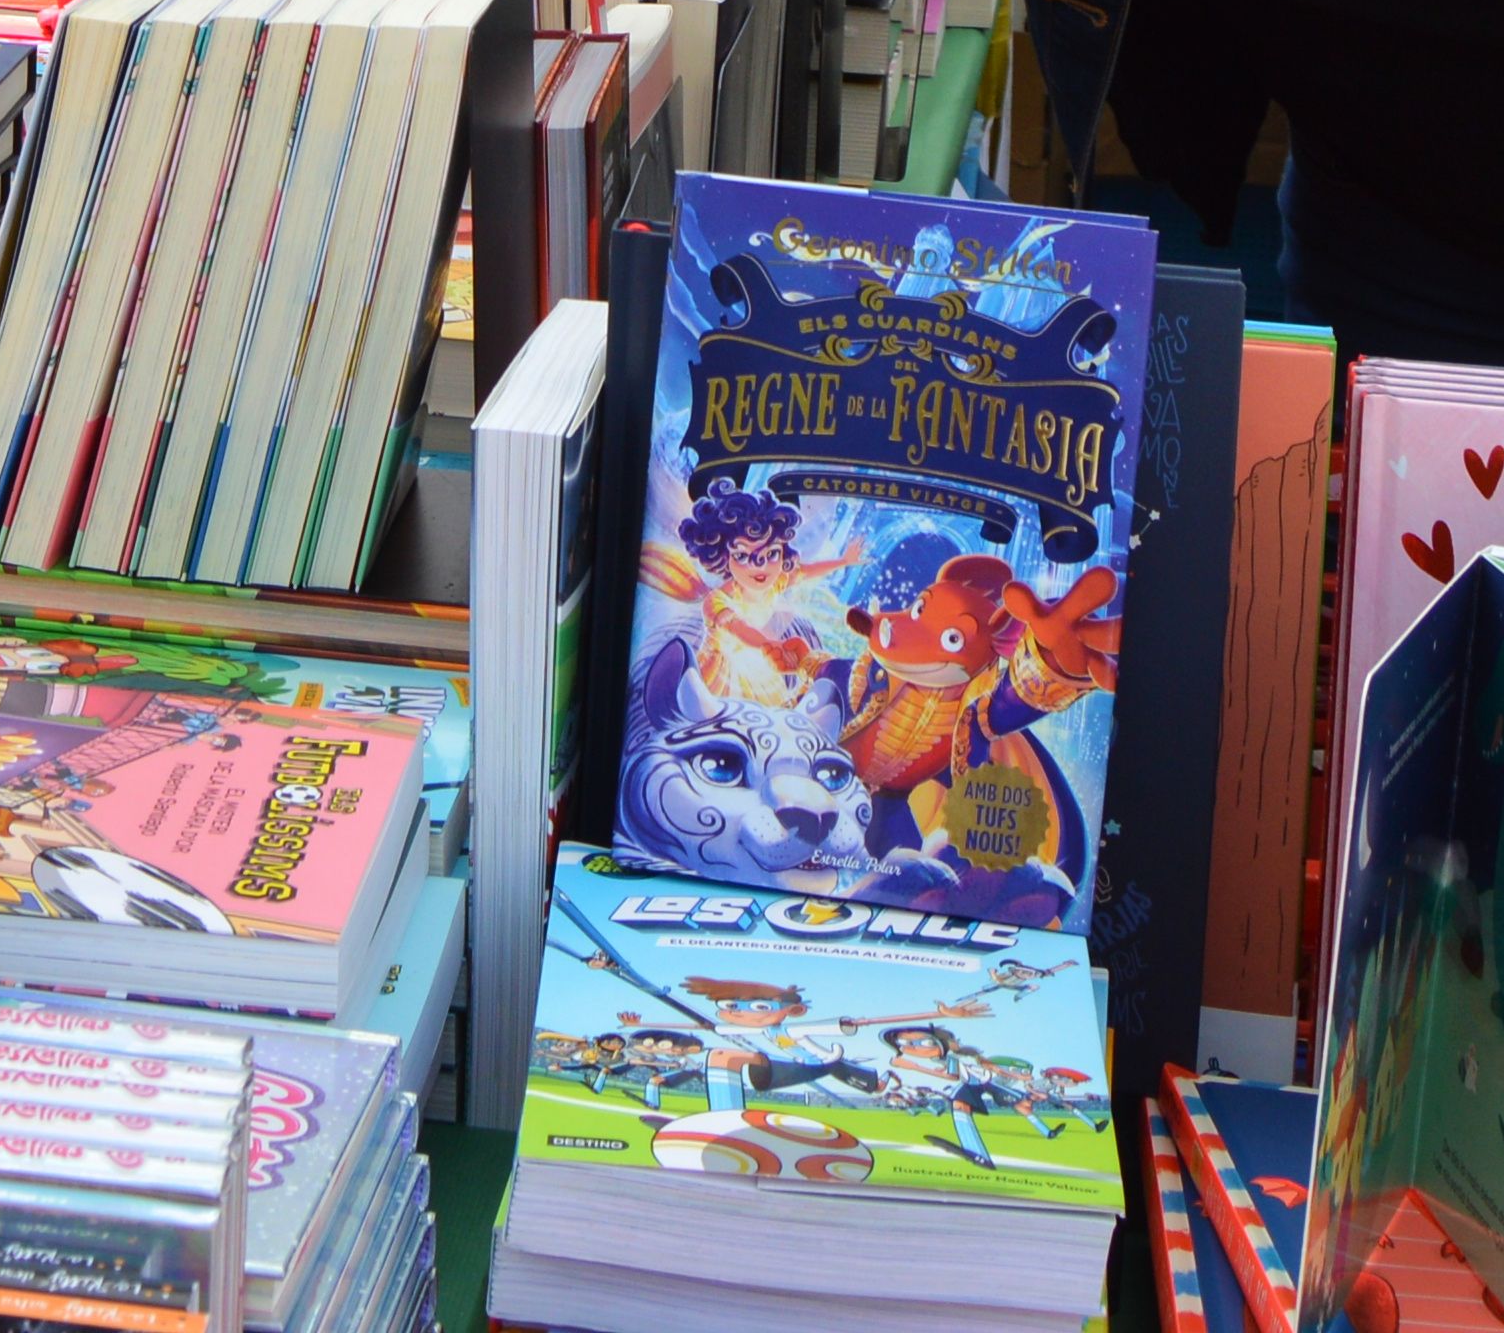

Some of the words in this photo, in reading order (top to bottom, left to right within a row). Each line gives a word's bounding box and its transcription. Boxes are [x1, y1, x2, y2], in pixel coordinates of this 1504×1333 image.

[798, 312, 849, 335] ELS
[857, 312, 1019, 361] GUARDIANS
[894, 359, 921, 374] DEL
[700, 372, 842, 454] REGNE
[845, 394, 865, 418] DE
[870, 396, 887, 420] LA
[887, 374, 1105, 508] FANTASIA
[910, 487, 988, 515] VIATGE
[962, 777, 999, 803] AMB
[1000, 782, 1033, 808] DOS
[974, 802, 1018, 831] TUFS
[964, 826, 1023, 858] NOUS!
[810, 848, 864, 871] Estrella
[864, 853, 905, 878] Polar
[608, 893, 766, 935] LOS
[667, 936, 687, 947] EL
[688, 937, 776, 953] DELANTERO
[777, 941, 804, 953] QUE
[803, 943, 860, 959] VOLABA
[860, 949, 880, 960] AL
[881, 950, 967, 970] ATARDECER
[551, 1136, 625, 1152] DESTINO
[961, 1170, 993, 1183] por
